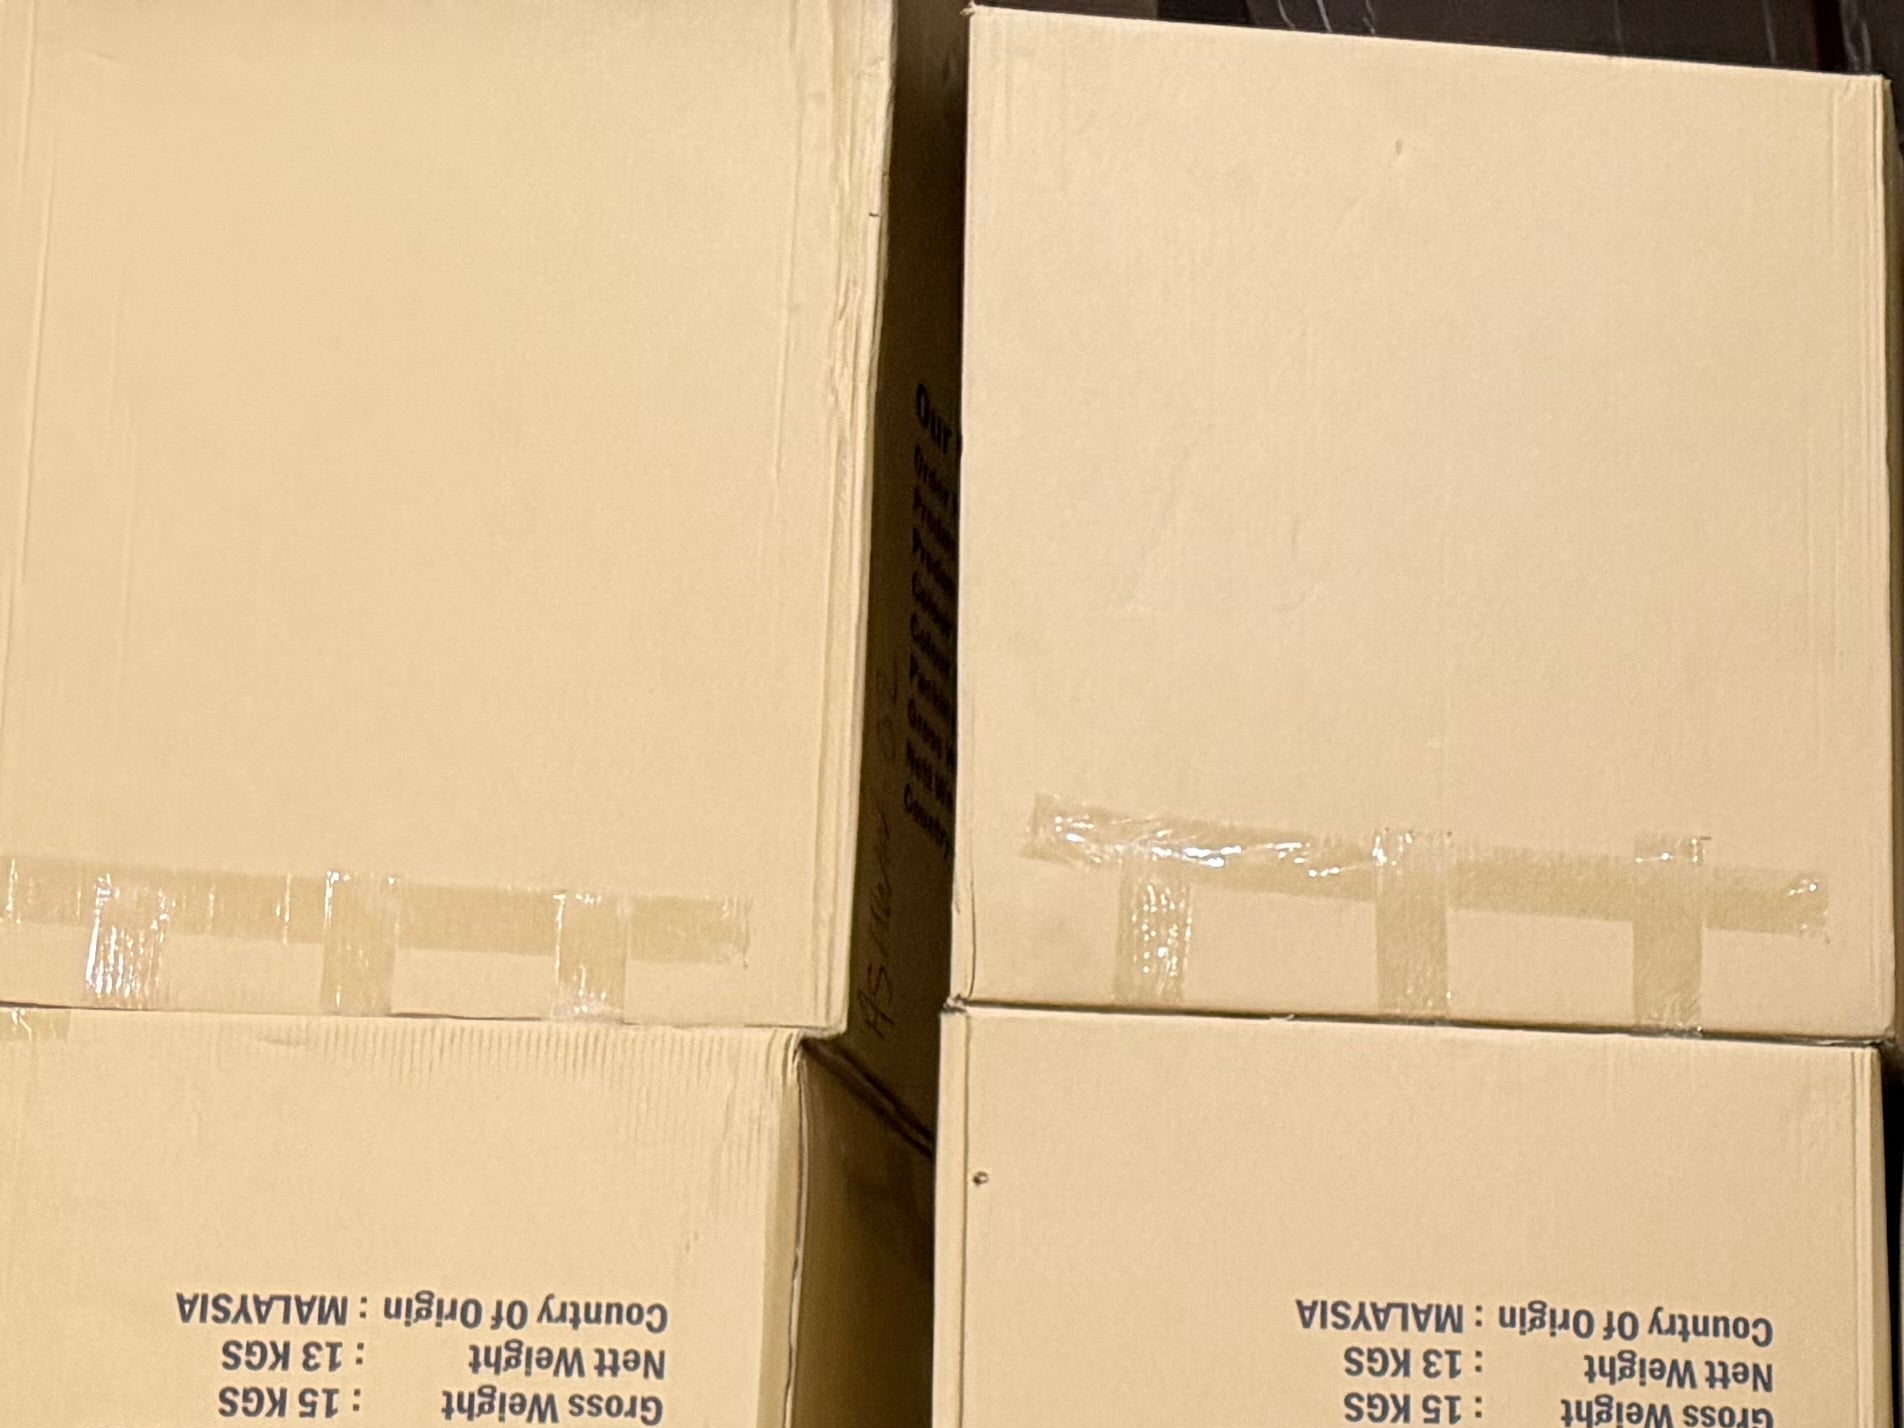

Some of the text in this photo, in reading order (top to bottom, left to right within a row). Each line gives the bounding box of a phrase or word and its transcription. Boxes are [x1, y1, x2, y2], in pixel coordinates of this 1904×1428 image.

[176, 1290, 667, 1334] Country Of Origin MALAYSIA
[1295, 1299, 1773, 1348] Country Of Origin MALAYSIA
